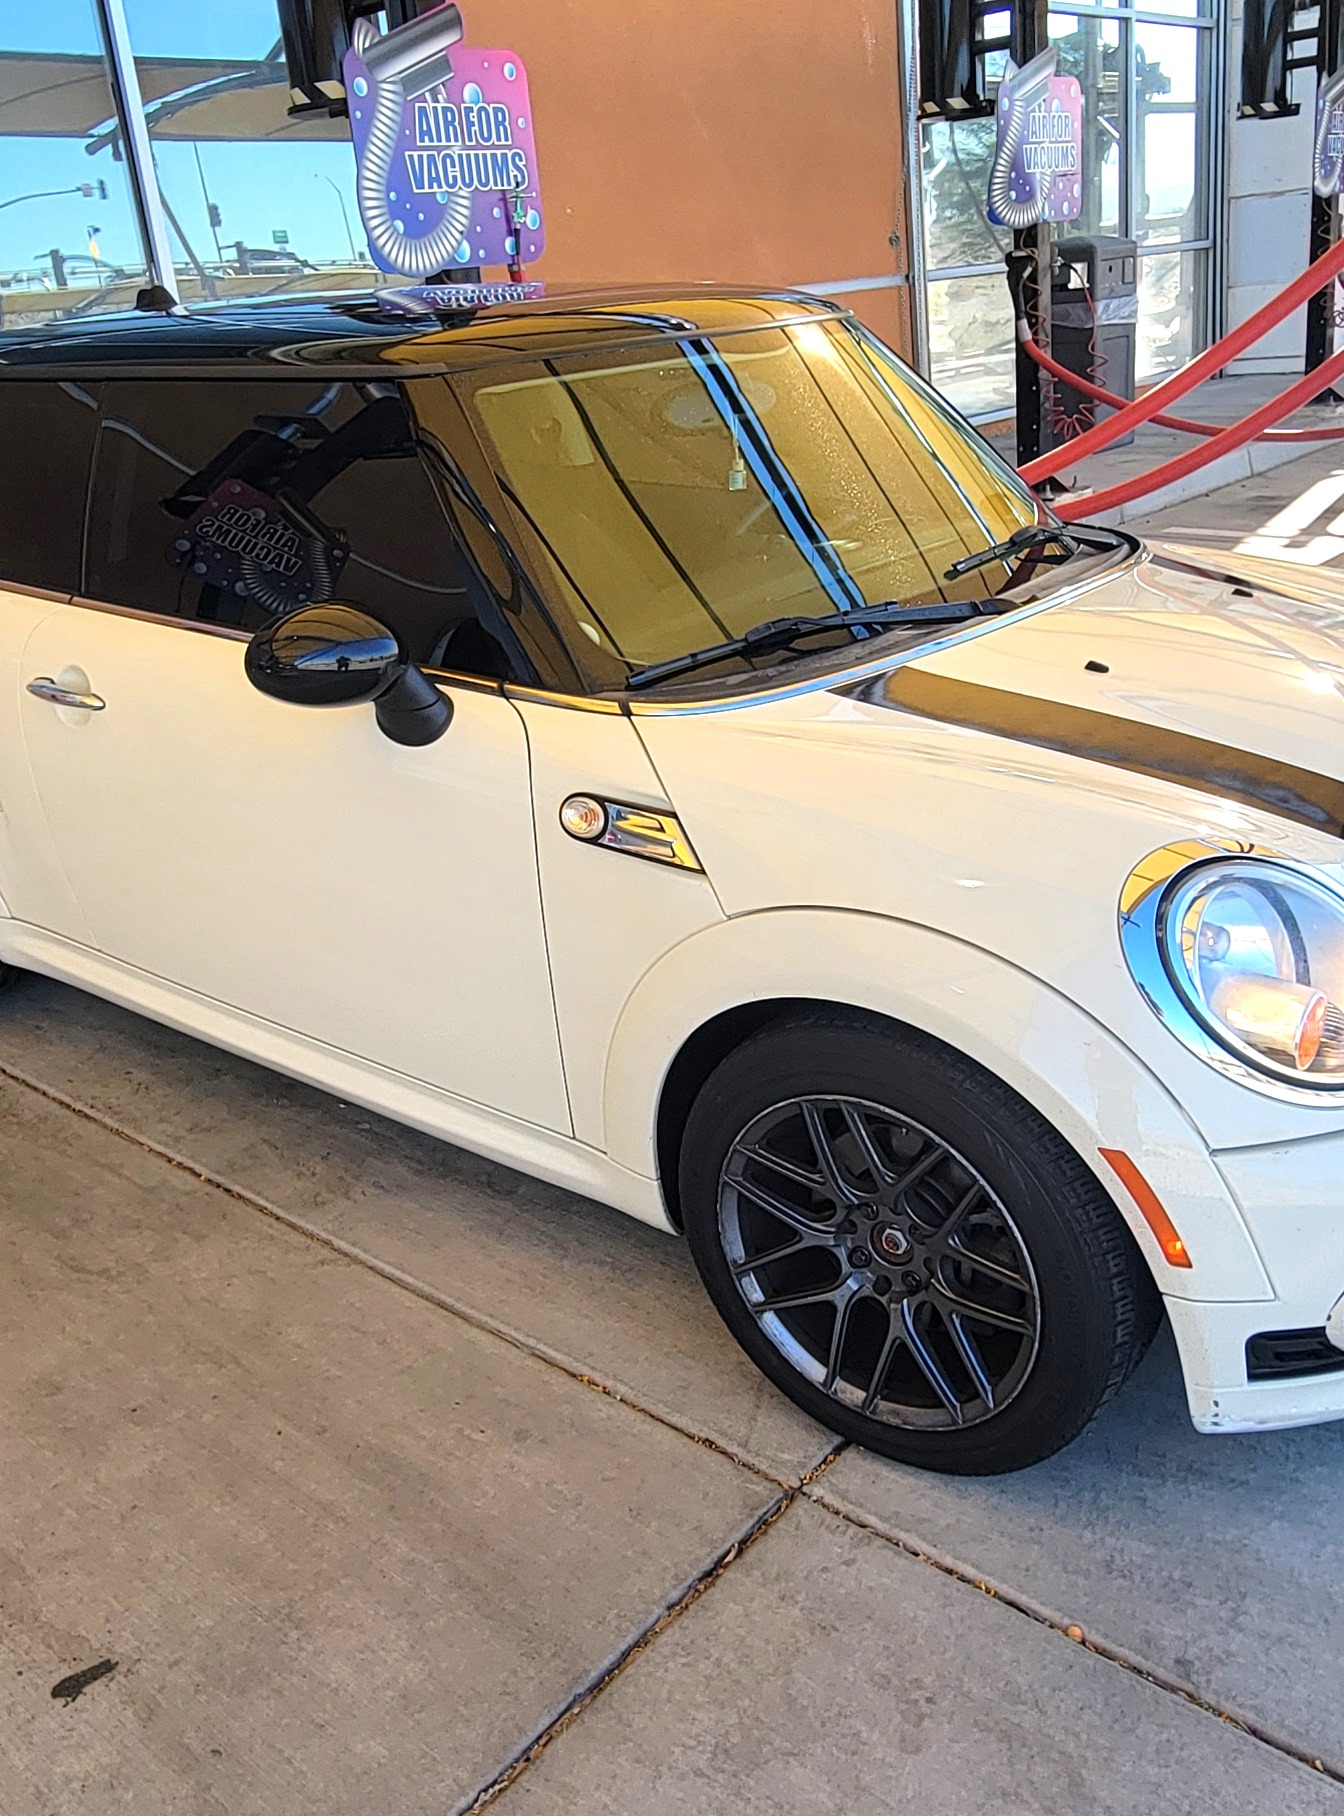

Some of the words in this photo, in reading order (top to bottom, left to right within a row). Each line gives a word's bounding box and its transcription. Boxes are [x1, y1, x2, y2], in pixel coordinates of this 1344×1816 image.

[415, 103, 461, 145] AIR
[461, 103, 512, 145] FOR
[1029, 112, 1049, 141] AIR
[1050, 112, 1072, 141] FOR
[405, 149, 528, 192] VACUUMS
[1023, 143, 1076, 172] VACUUMS
